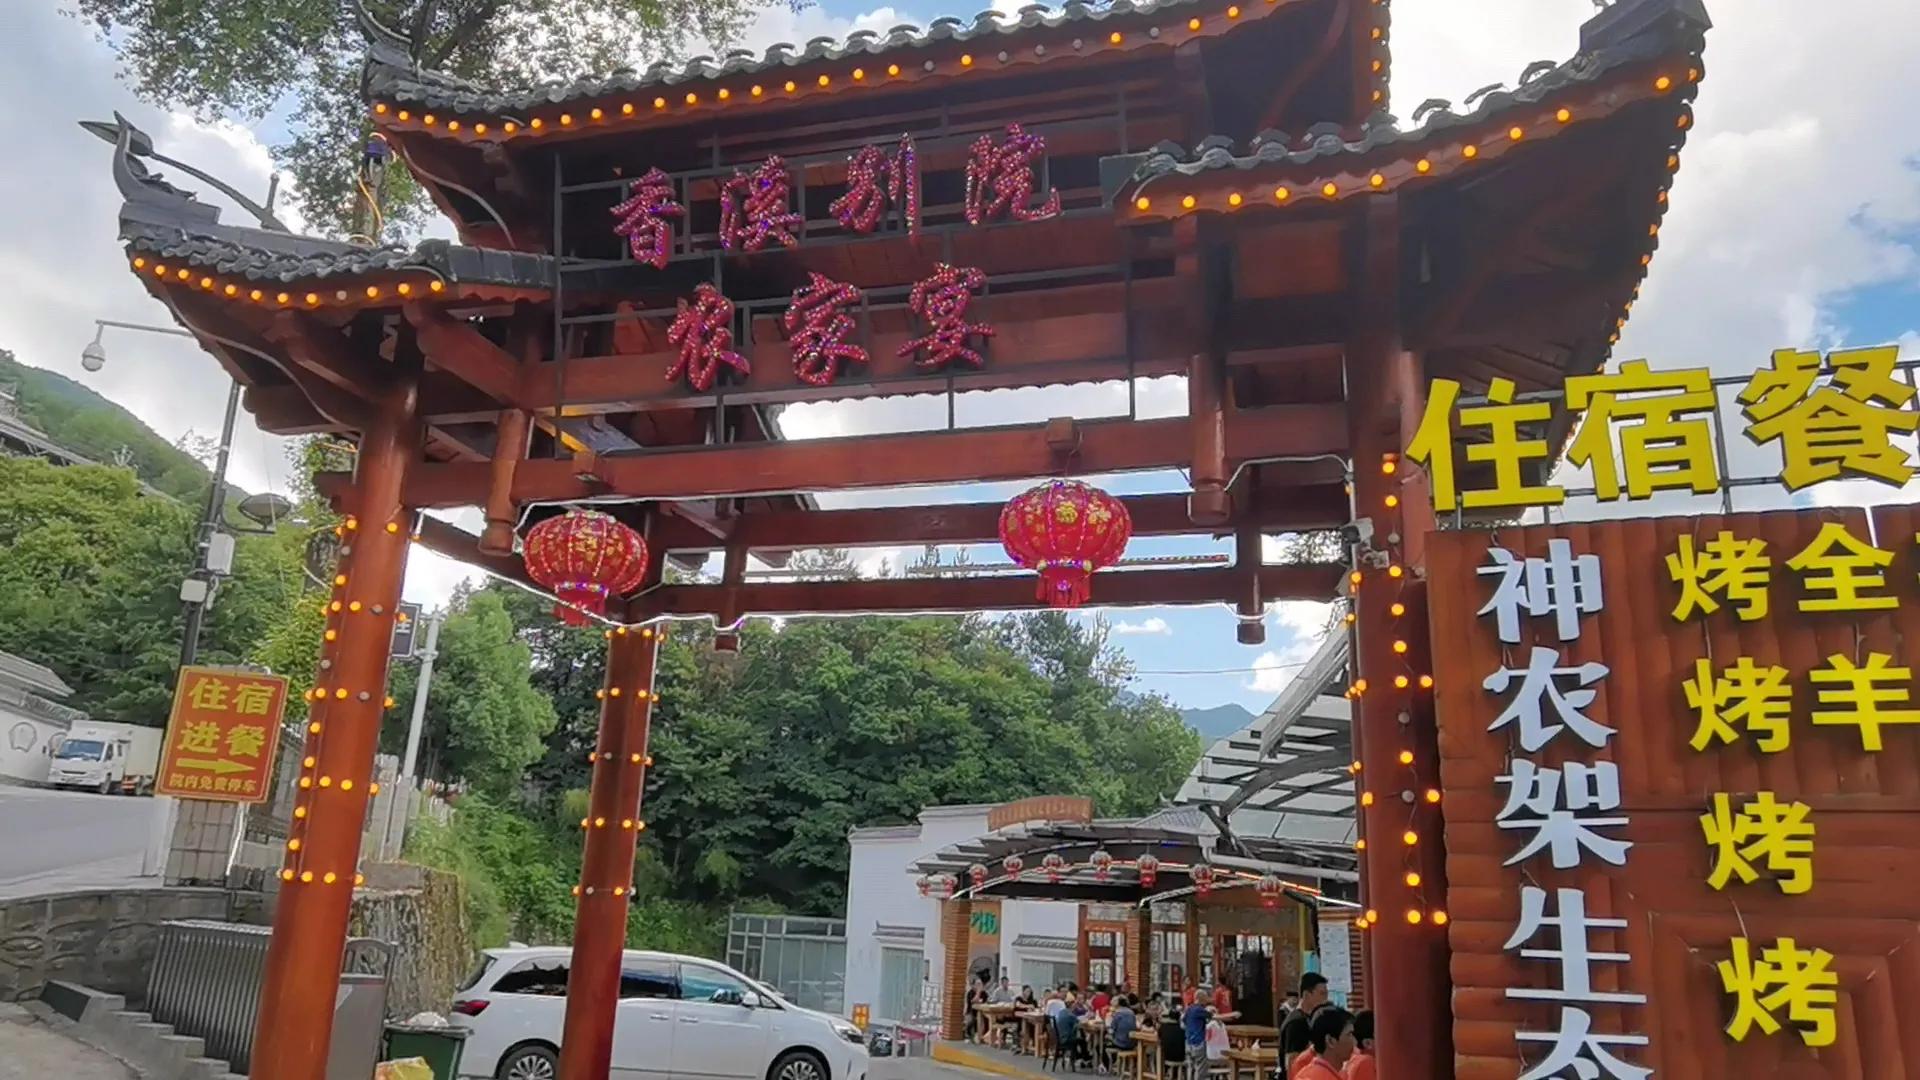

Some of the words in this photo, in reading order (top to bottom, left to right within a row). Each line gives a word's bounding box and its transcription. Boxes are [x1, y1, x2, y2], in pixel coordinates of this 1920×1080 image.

[1406, 346, 1920, 511] 住宿餐
[1666, 522, 1920, 622] 烤全
[188, 677, 276, 715] 住宿
[177, 720, 265, 758] 进餐
[169, 773, 256, 792] 院内免费停车
